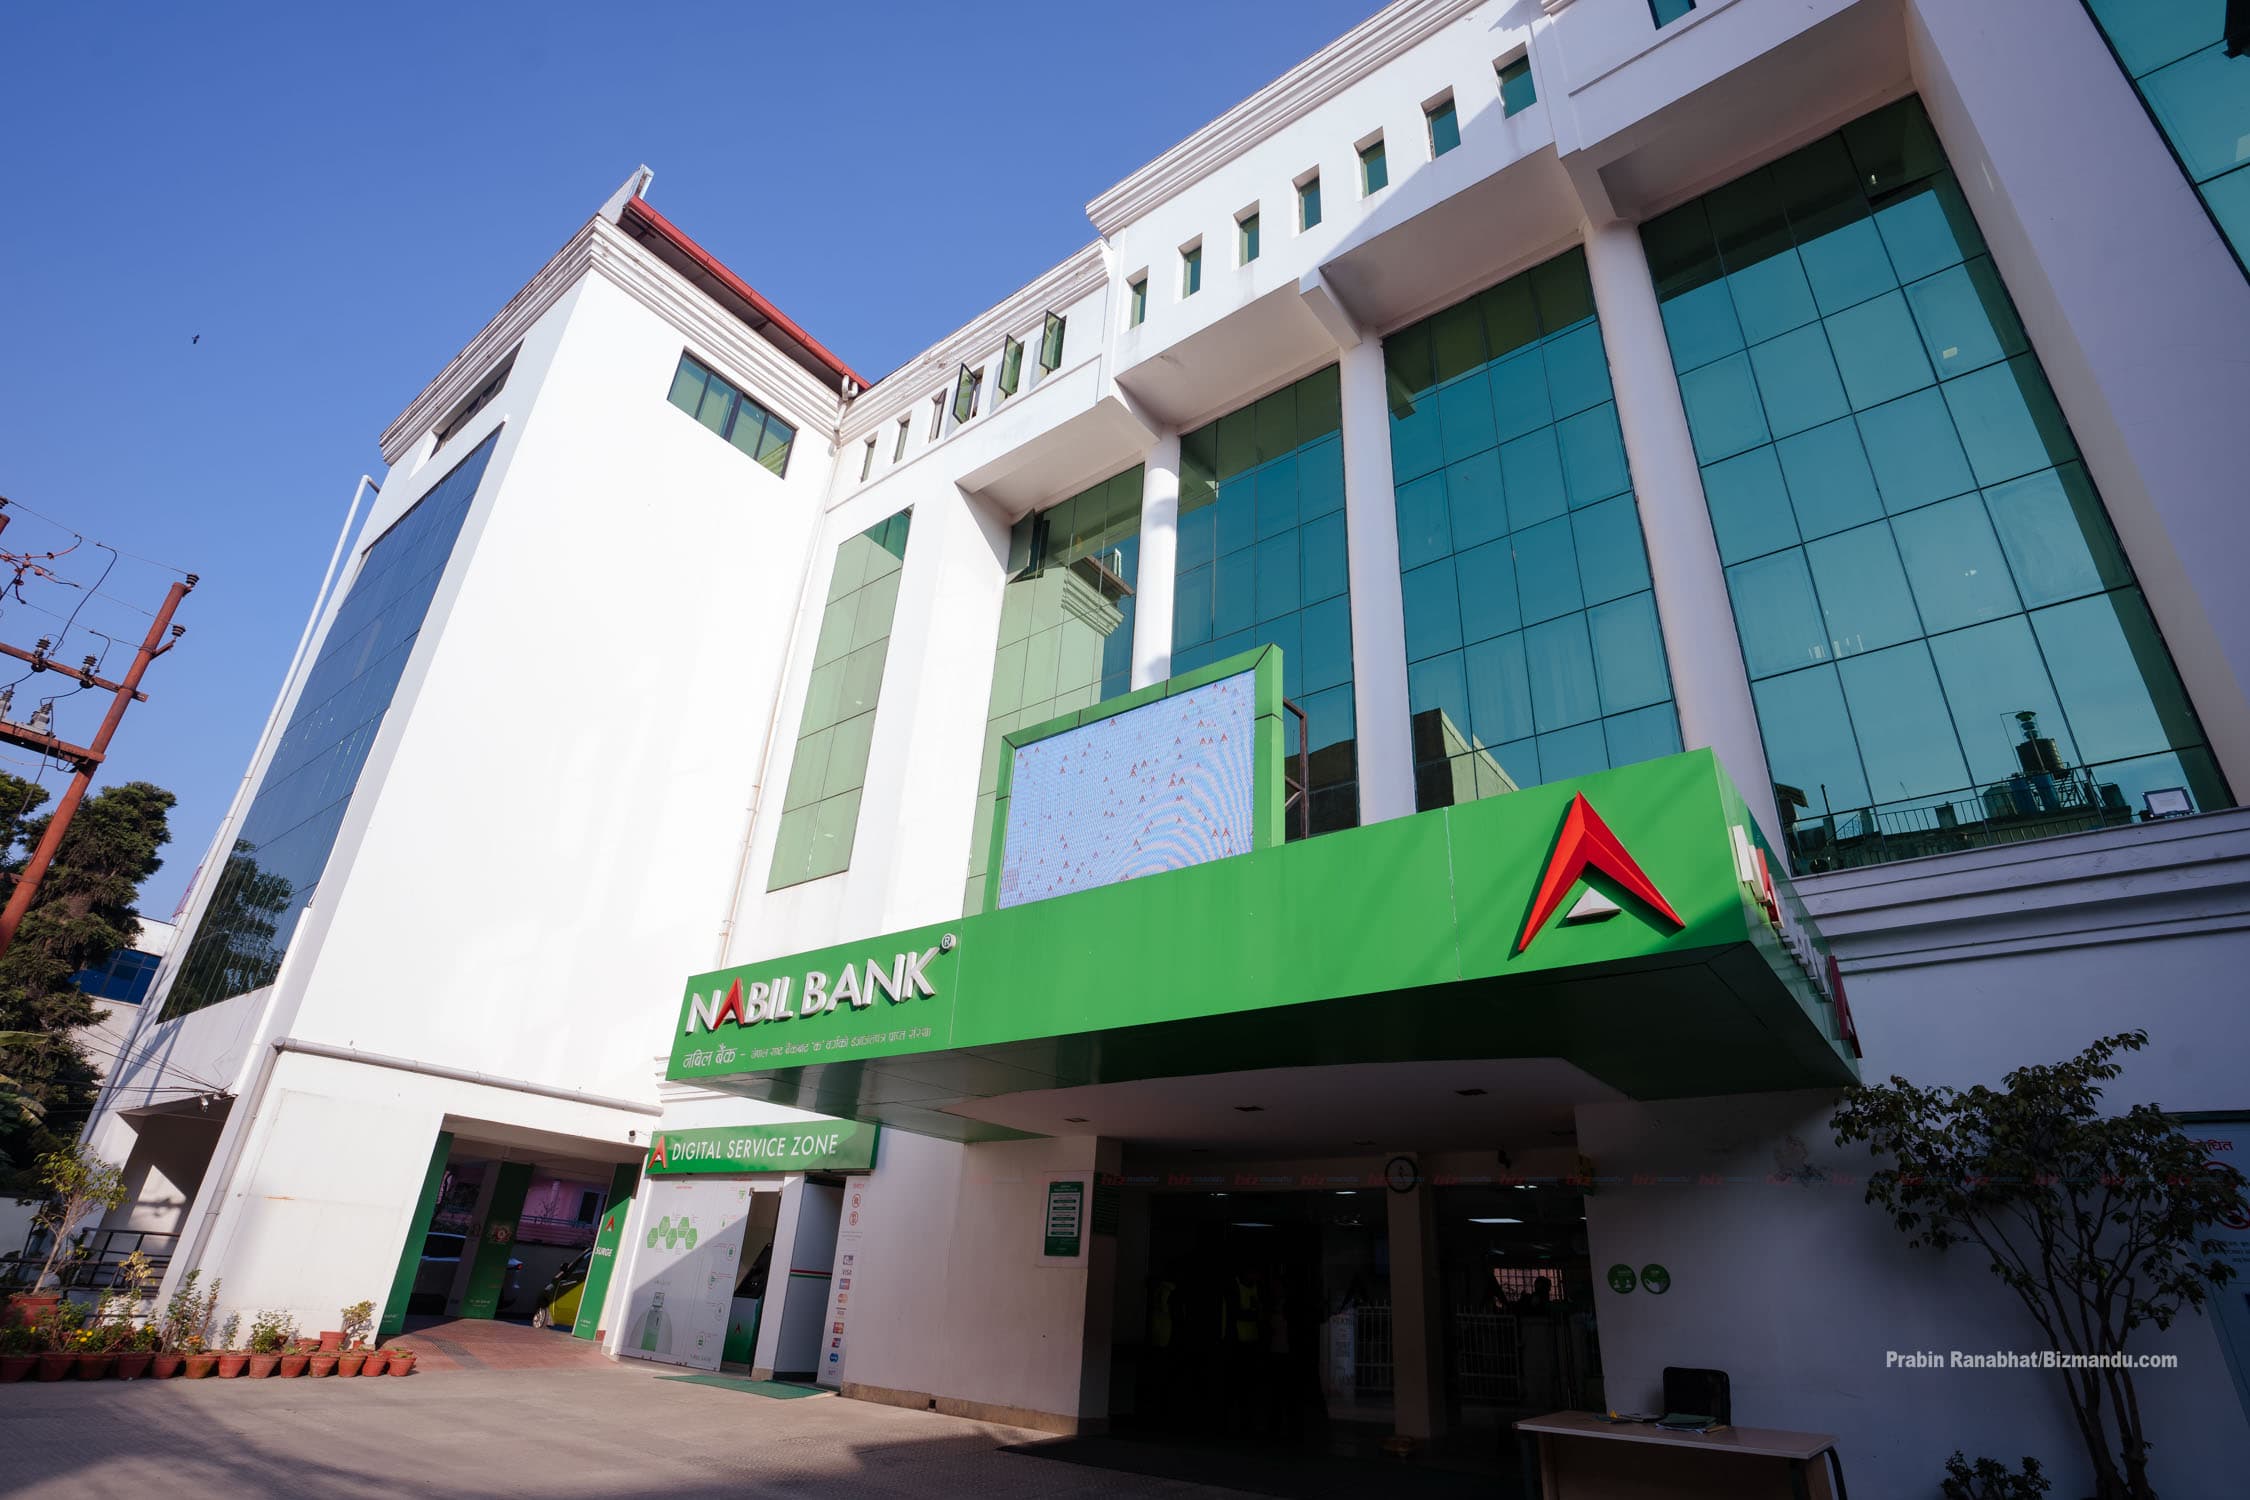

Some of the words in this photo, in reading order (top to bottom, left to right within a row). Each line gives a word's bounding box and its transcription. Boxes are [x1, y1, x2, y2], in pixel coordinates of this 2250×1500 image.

[685, 976, 794, 1033] NABIL
[800, 947, 940, 1016] BANK
[683, 1049, 714, 1069] नबिल
[672, 1141, 721, 1161] DIGITAL
[727, 1137, 786, 1159] SERVICE
[791, 1134, 839, 1157] ZONE
